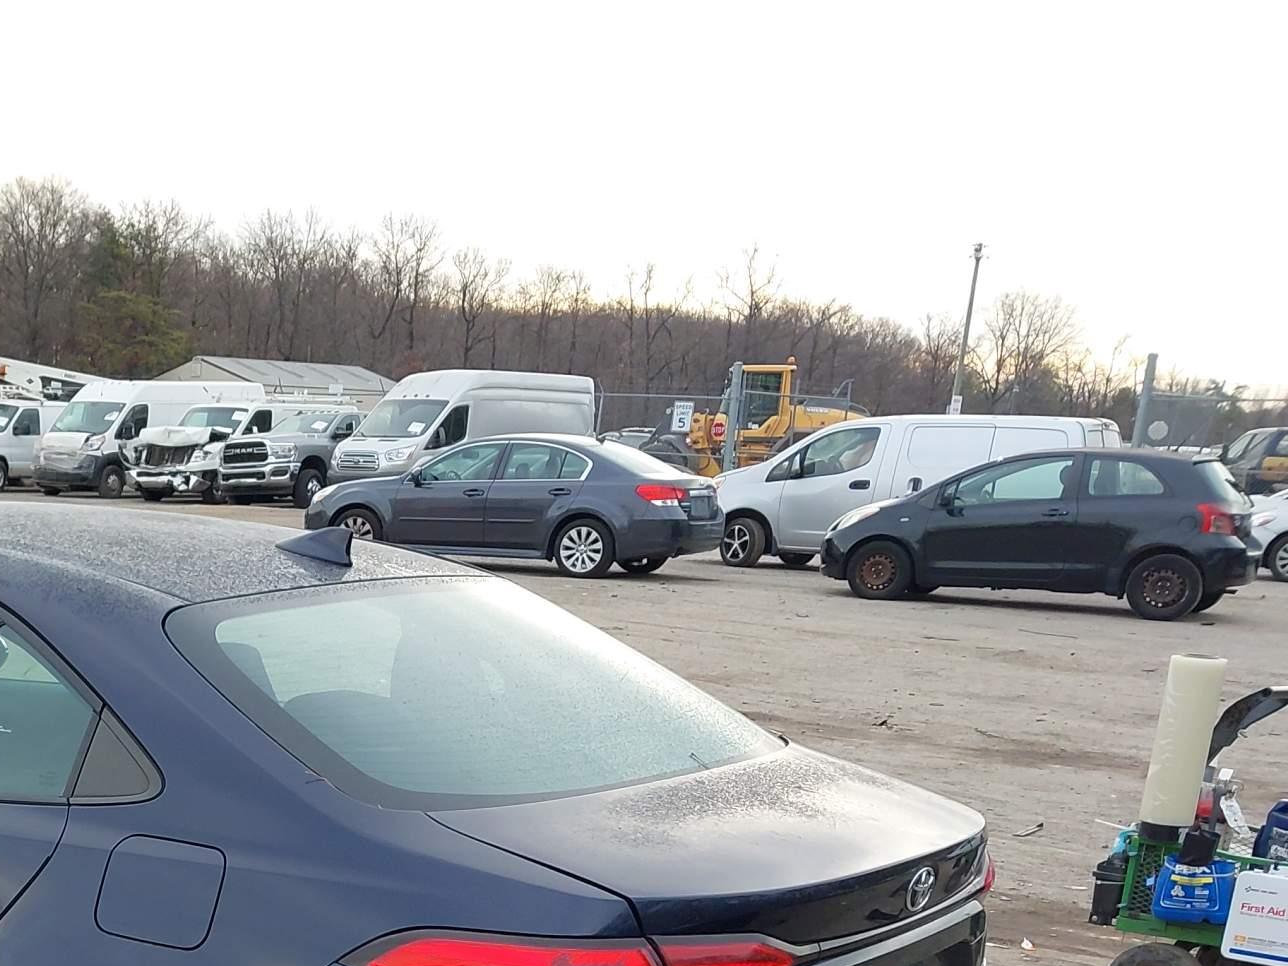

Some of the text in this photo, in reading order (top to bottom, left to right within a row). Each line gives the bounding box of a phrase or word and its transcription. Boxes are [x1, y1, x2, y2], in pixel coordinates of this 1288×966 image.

[678, 417, 686, 428] 5
[1240, 902, 1265, 914] First
[1267, 905, 1286, 917] Aid
